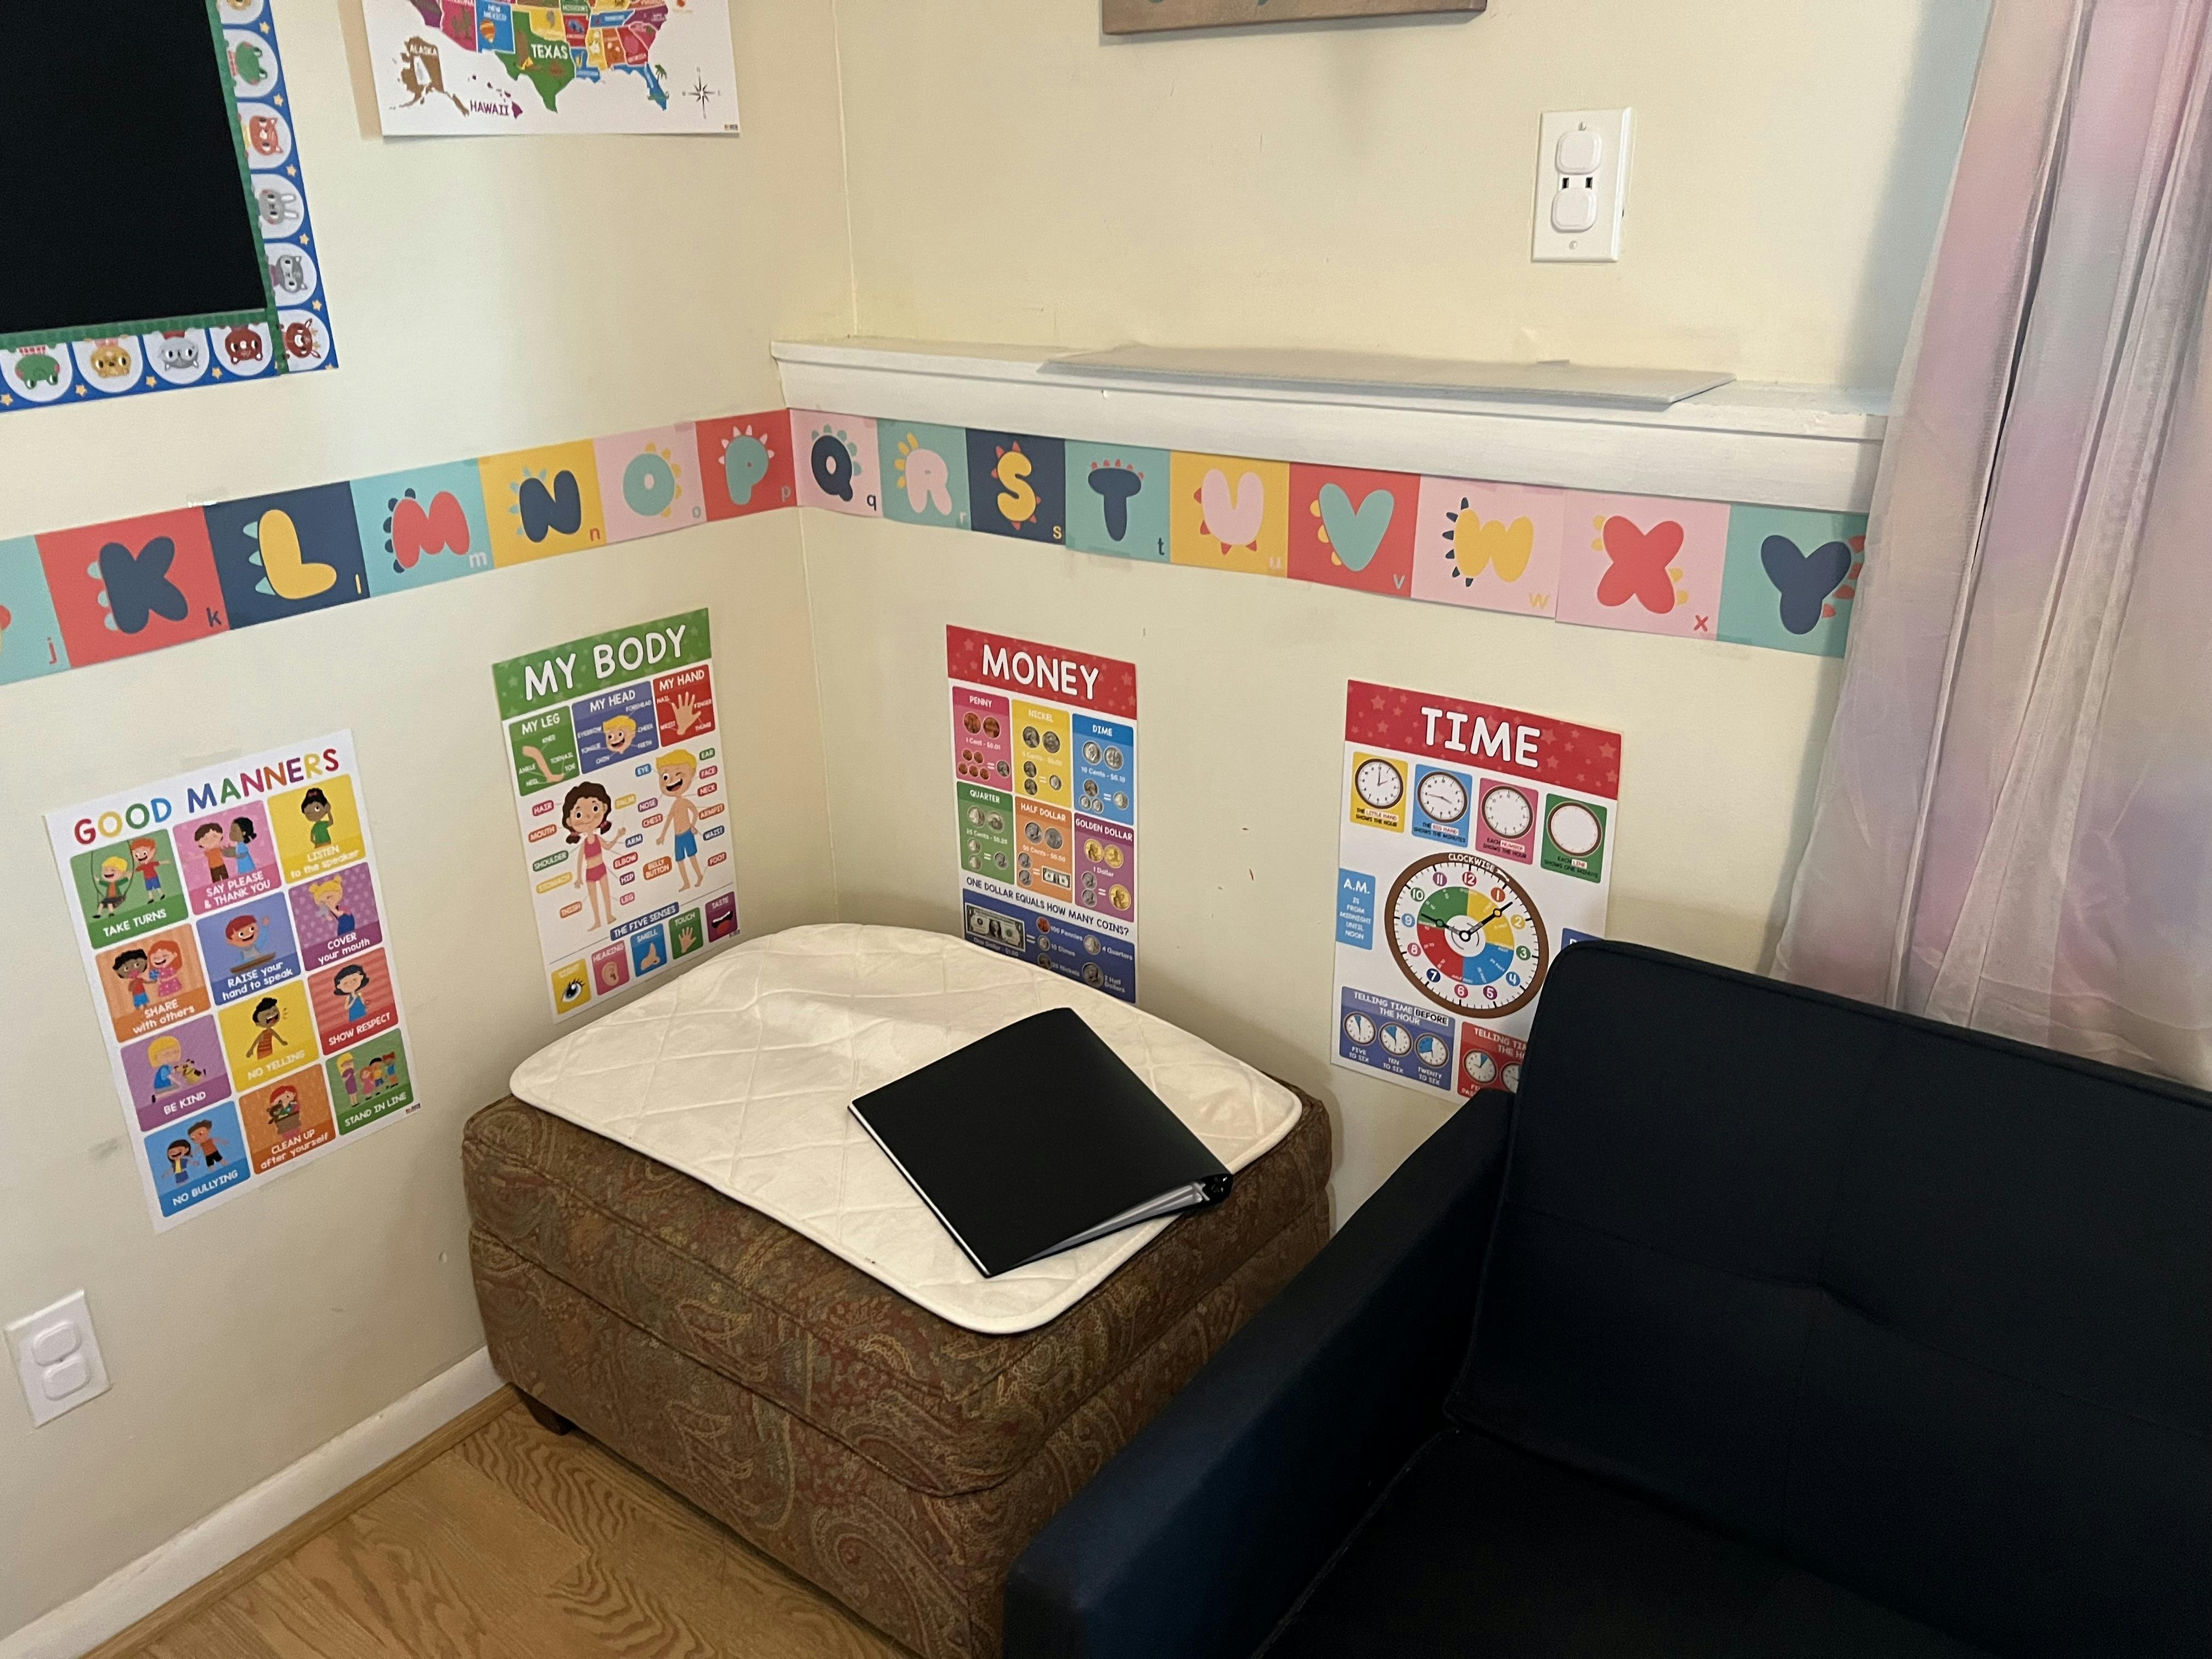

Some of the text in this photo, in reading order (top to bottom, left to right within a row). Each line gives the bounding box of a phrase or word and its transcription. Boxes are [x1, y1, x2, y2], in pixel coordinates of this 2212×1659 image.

[488, 4, 500, 13] NEW
[531, 44, 568, 59] TEXAS
[470, 100, 509, 115] HAWAII
[811, 434, 1852, 635] Q q R r S s T t U u V v W w X x Y
[47, 636, 58, 665] j
[99, 535, 188, 634] K
[206, 607, 222, 628] k
[258, 510, 337, 600] L
[392, 490, 470, 568] M
[469, 550, 488, 568] m
[519, 470, 582, 543] N
[589, 526, 601, 541] n
[623, 453, 675, 516] O
[692, 505, 701, 519] o
[725, 435, 769, 505] P
[781, 485, 791, 503] p
[524, 624, 686, 701] MY BODY
[982, 644, 1099, 700] MONEY
[659, 670, 704, 691] MY HAND
[590, 690, 635, 712] MY HEAD
[969, 695, 992, 708] PENNY
[1028, 709, 1053, 723] NICKEL
[522, 713, 560, 735] MY LEG
[1092, 724, 1113, 737] DIME
[1420, 706, 1541, 768] TIME
[701, 749, 713, 758] EAR
[637, 766, 648, 774] EYE
[74, 748, 340, 844] GOOD MANNERS
[700, 785, 715, 794] NECK
[970, 789, 1000, 803] QUARTER
[534, 802, 552, 814] HAIR
[1020, 803, 1066, 821] HALF DOLLAR
[531, 826, 555, 840] MOUTH
[1075, 819, 1132, 842] GOLDEN DOLLAR
[627, 836, 642, 845] ARM
[307, 845, 340, 862] LISTEN
[534, 852, 567, 870] SHOULDER
[614, 854, 637, 867] ELBOW
[709, 853, 725, 865] FOOT
[291, 850, 360, 878] to the speaker
[1448, 853, 1496, 871] CLOCKWISE
[621, 874, 634, 883] HIP
[646, 864, 669, 878] BUTTON
[206, 870, 264, 898] SAY PLEASE
[1344, 878, 1370, 894] A.M.
[1437, 873, 1443, 885] 11
[1464, 873, 1475, 885] 12
[204, 879, 271, 909] & THANK YOU
[621, 894, 634, 903] LEG
[1413, 888, 1424, 900] 10
[1496, 890, 1500, 900] 1
[712, 896, 729, 909] TASTE
[966, 876, 1129, 936] ONE DOLLAR EQUALS HOW MANY COINS?
[1347, 904, 1364, 914] FROM
[103, 909, 167, 937] TAKE TURNS
[613, 906, 676, 938] THE FIVE SENSES
[675, 912, 696, 926] TOUCH
[1340, 911, 1370, 924] MIDNIGHT
[1404, 916, 1412, 925] 9
[1514, 917, 1522, 927] 2
[1346, 921, 1364, 932] UNTIL
[328, 932, 357, 950] COVER
[637, 929, 658, 943] SMELL
[1345, 930, 1364, 939] NOON
[318, 938, 370, 965] your mouth
[593, 943, 624, 961] HEARING
[1520, 948, 1527, 958] 3
[227, 961, 283, 988] RAISE your
[1430, 970, 1437, 981] 7
[1509, 973, 1516, 985] 4
[222, 968, 293, 1001] hand to speak
[1457, 986, 1465, 996] 6
[1486, 988, 1494, 997] 5
[144, 999, 179, 1019] SHARE
[1354, 991, 1447, 1025] TELLING TIME BEFORE
[132, 1005, 195, 1034] with others
[1379, 1007, 1420, 1025] THE HOUR
[329, 1012, 391, 1046] SHOW RESPECT
[1351, 1046, 1367, 1056] FIVE
[1498, 1044, 1514, 1057] THE
[247, 1049, 306, 1080] NO YELLING
[163, 1091, 206, 1115] BE KIND
[344, 1092, 407, 1127] STAND IN LINE
[271, 1129, 315, 1154] CLEAN UP
[261, 1132, 329, 1170] after yourself
[173, 1170, 239, 1206] NO BULLYING
